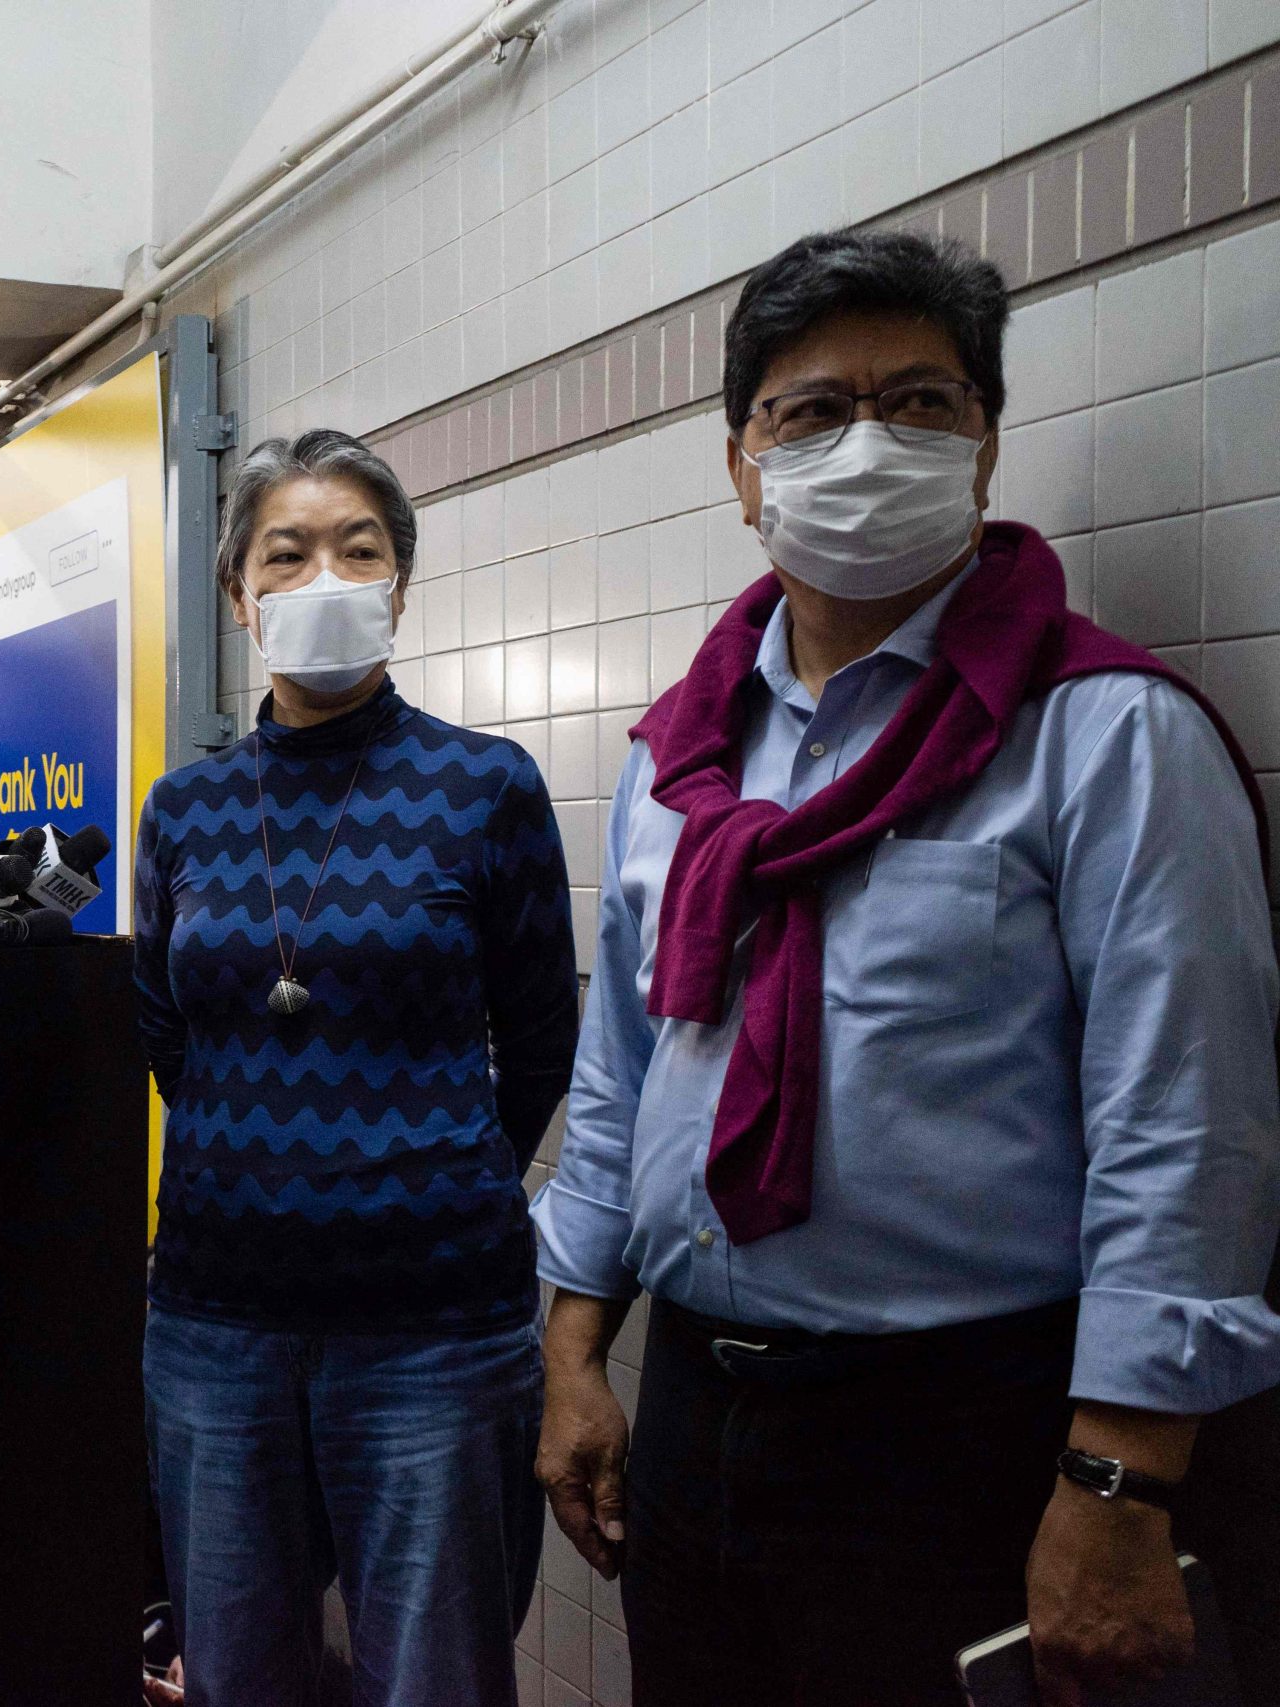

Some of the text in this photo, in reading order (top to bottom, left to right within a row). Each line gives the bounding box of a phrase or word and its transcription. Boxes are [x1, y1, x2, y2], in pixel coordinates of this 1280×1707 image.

[58, 546, 88, 571] FOLLOW
[41, 752, 83, 810] You
[44, 873, 93, 909] TMHK
